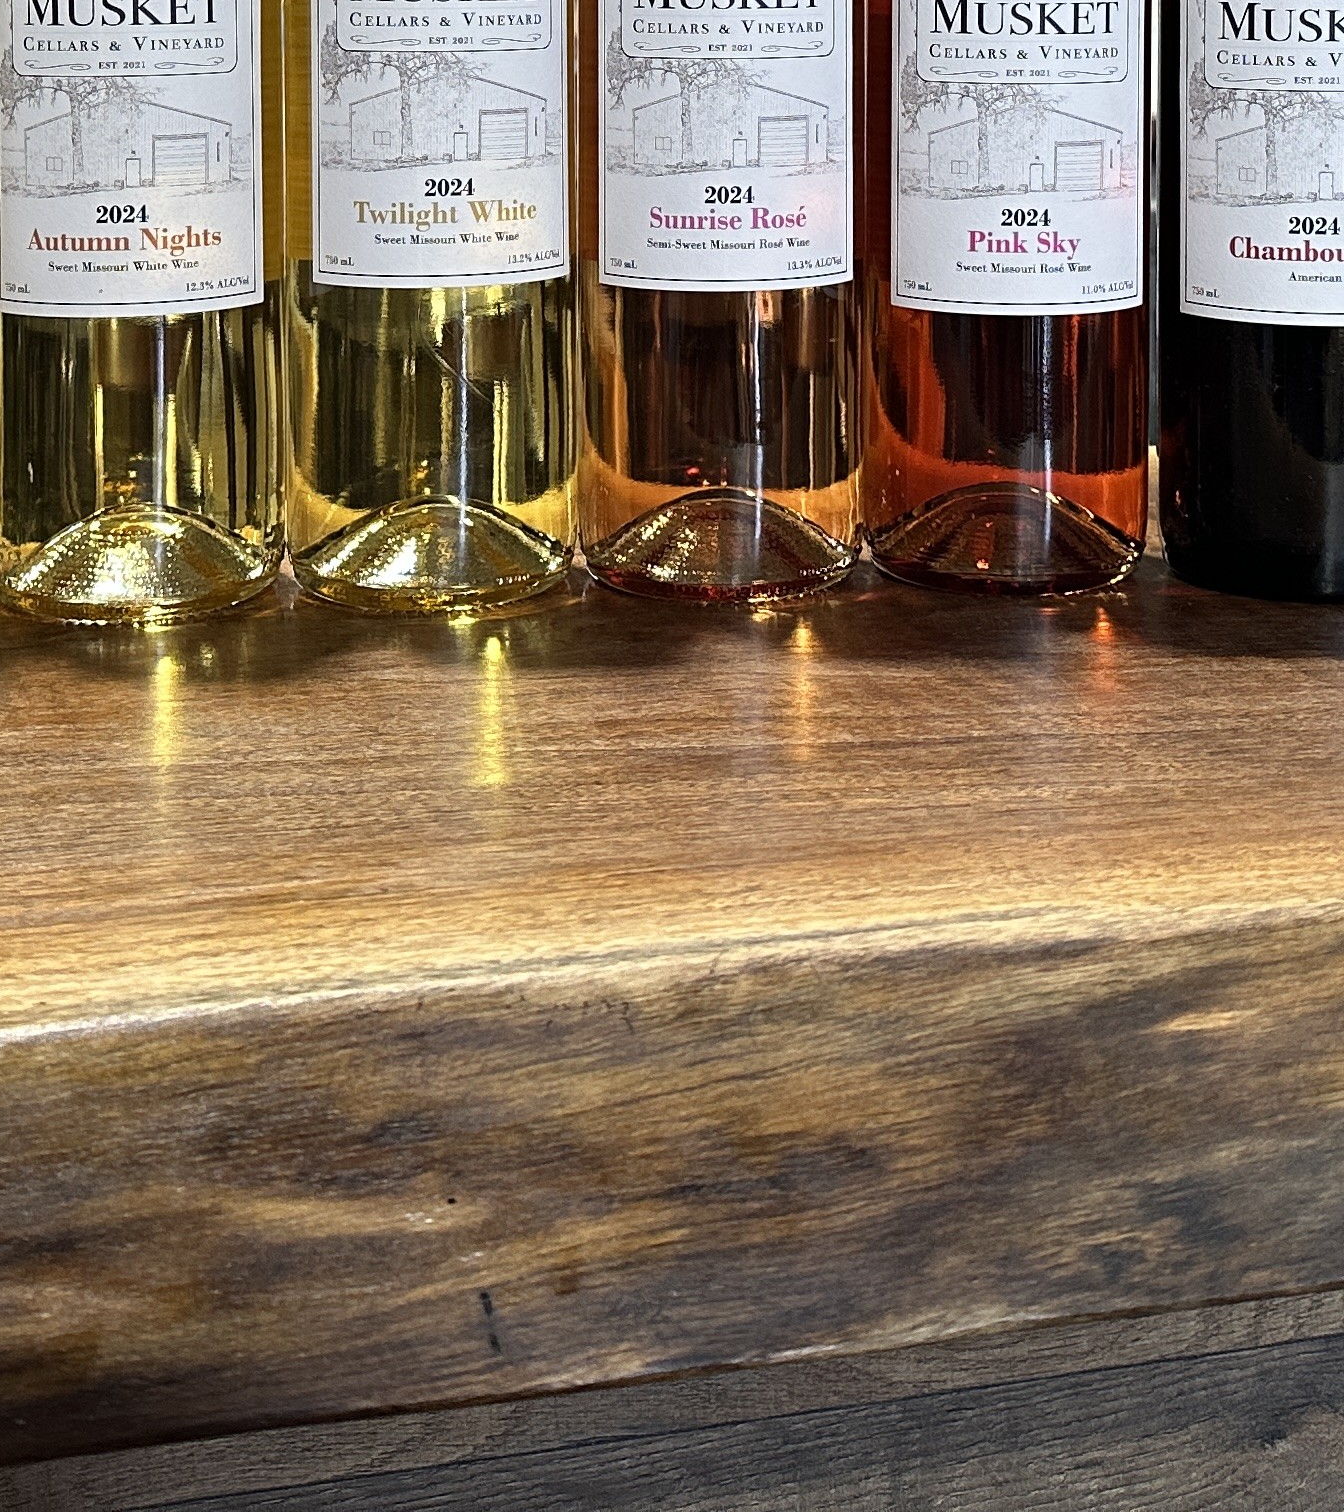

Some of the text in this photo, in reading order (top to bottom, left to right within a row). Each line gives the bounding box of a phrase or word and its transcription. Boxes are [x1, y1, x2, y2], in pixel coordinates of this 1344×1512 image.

[349, 11, 542, 28] CELLARS & VINEYARD
[632, 19, 824, 35] CELLARS & VINEYARD
[23, 36, 224, 53] CELLARS & VINEYARD
[452, 36, 474, 44] 2021
[731, 43, 753, 51] 2021
[928, 43, 1119, 59] CELLARS & VINEYARD
[1216, 50, 1296, 67] CELLARS
[1305, 55, 1317, 66] &
[122, 60, 146, 69] 2021
[1029, 69, 1051, 77] 2021
[1318, 76, 1341, 84] 2021
[424, 178, 475, 197] 2024
[705, 186, 755, 204] 2024
[96, 205, 149, 224] 2024
[354, 199, 537, 232] Twilight White
[649, 206, 807, 230] Sunrise Rosé
[1001, 208, 1051, 227] 2024
[1288, 216, 1340, 235] 2024
[26, 225, 222, 256] Autumn Nights
[375, 231, 519, 245] Sweet Missouri White Wine
[647, 237, 810, 250] Semi-Sweet Missouri Rosé Wine
[967, 230, 1081, 259] Pink Sky
[48, 259, 199, 272] Sweet Missouri White Wine
[956, 261, 987, 273] Sweet
[990, 263, 1036, 273] Missouri
[1068, 263, 1091, 272] Wine
[1288, 272, 1342, 282] American
